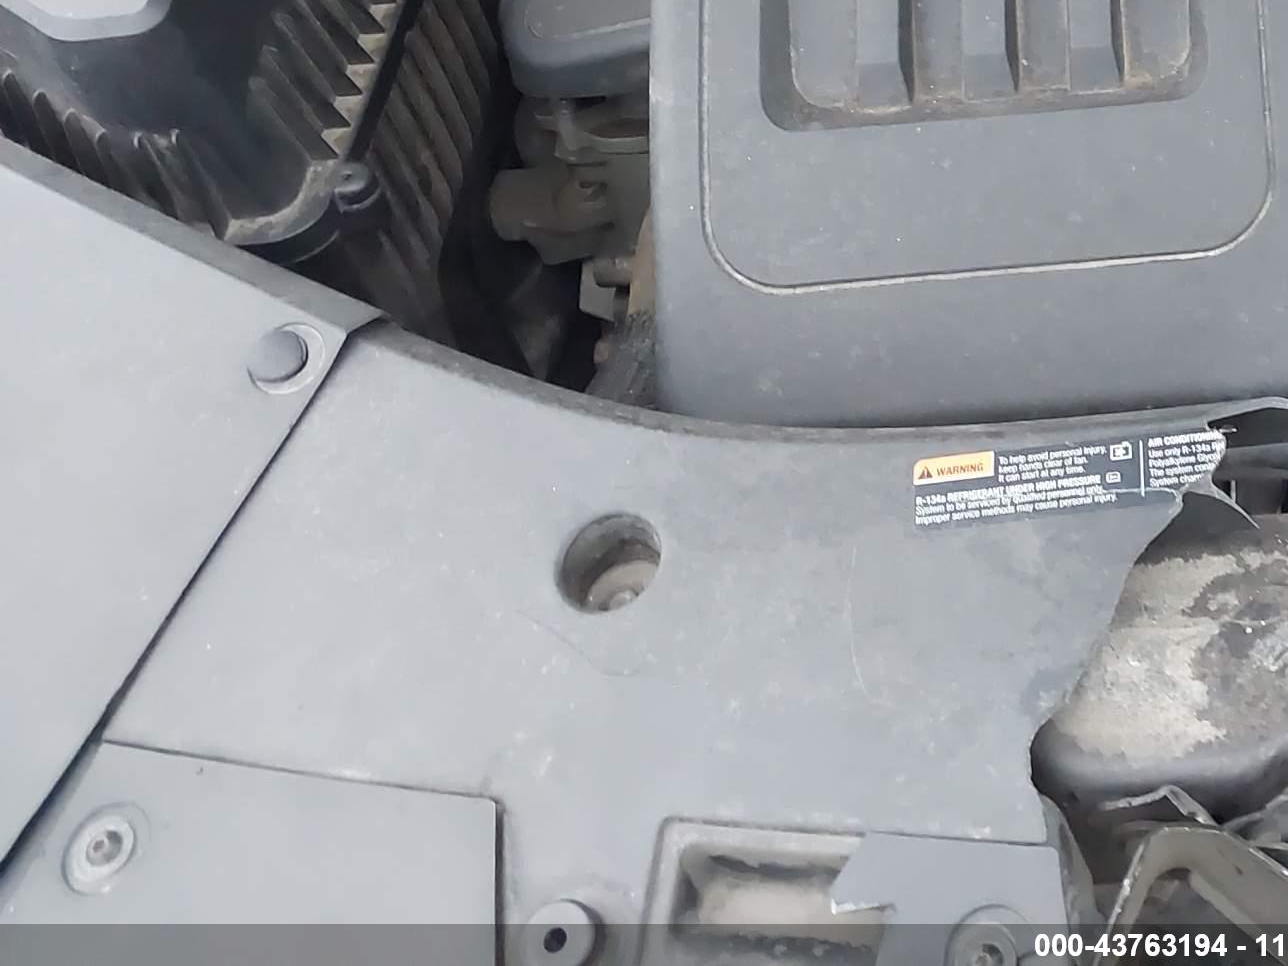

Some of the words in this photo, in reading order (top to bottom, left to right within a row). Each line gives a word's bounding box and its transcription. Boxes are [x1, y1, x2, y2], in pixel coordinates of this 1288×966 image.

[1147, 437, 1163, 448] AIR
[1148, 449, 1164, 459] Use
[1164, 447, 1181, 458] only
[1181, 442, 1211, 455] R-134a
[998, 456, 1008, 465] To
[1009, 454, 1027, 466] help
[1027, 451, 1049, 462] avoid
[1049, 446, 1082, 460] personal
[936, 463, 984, 477] WARNING
[998, 464, 1018, 475] keep
[1018, 461, 1043, 472] hands
[1043, 459, 1063, 469] clear
[1063, 457, 1073, 467] of
[1005, 473, 1021, 483] can
[1021, 469, 1040, 480] start
[1040, 468, 1049, 478] at
[1049, 466, 1065, 478] any
[1149, 467, 1165, 478] The
[1165, 464, 1194, 477] system
[915, 493, 946, 506] R-134a
[946, 485, 1005, 502] REFRIGERANT
[1005, 481, 1035, 497] UNDER
[1035, 479, 1057, 492] HIGH
[1057, 474, 1101, 489] PRESSURE
[1149, 476, 1179, 488] System
[915, 504, 946, 517] System
[955, 502, 966, 511] be
[967, 498, 1001, 510] serviced
[1001, 497, 1012, 508] by
[1012, 492, 1047, 504] qualified
[1047, 486, 1086, 500] personnel
[915, 513, 951, 526] Improper
[951, 509, 981, 520] service
[981, 505, 1015, 517] methods
[1016, 502, 1034, 514] may
[1034, 499, 1058, 511] cause
[1059, 496, 1093, 509] personal
